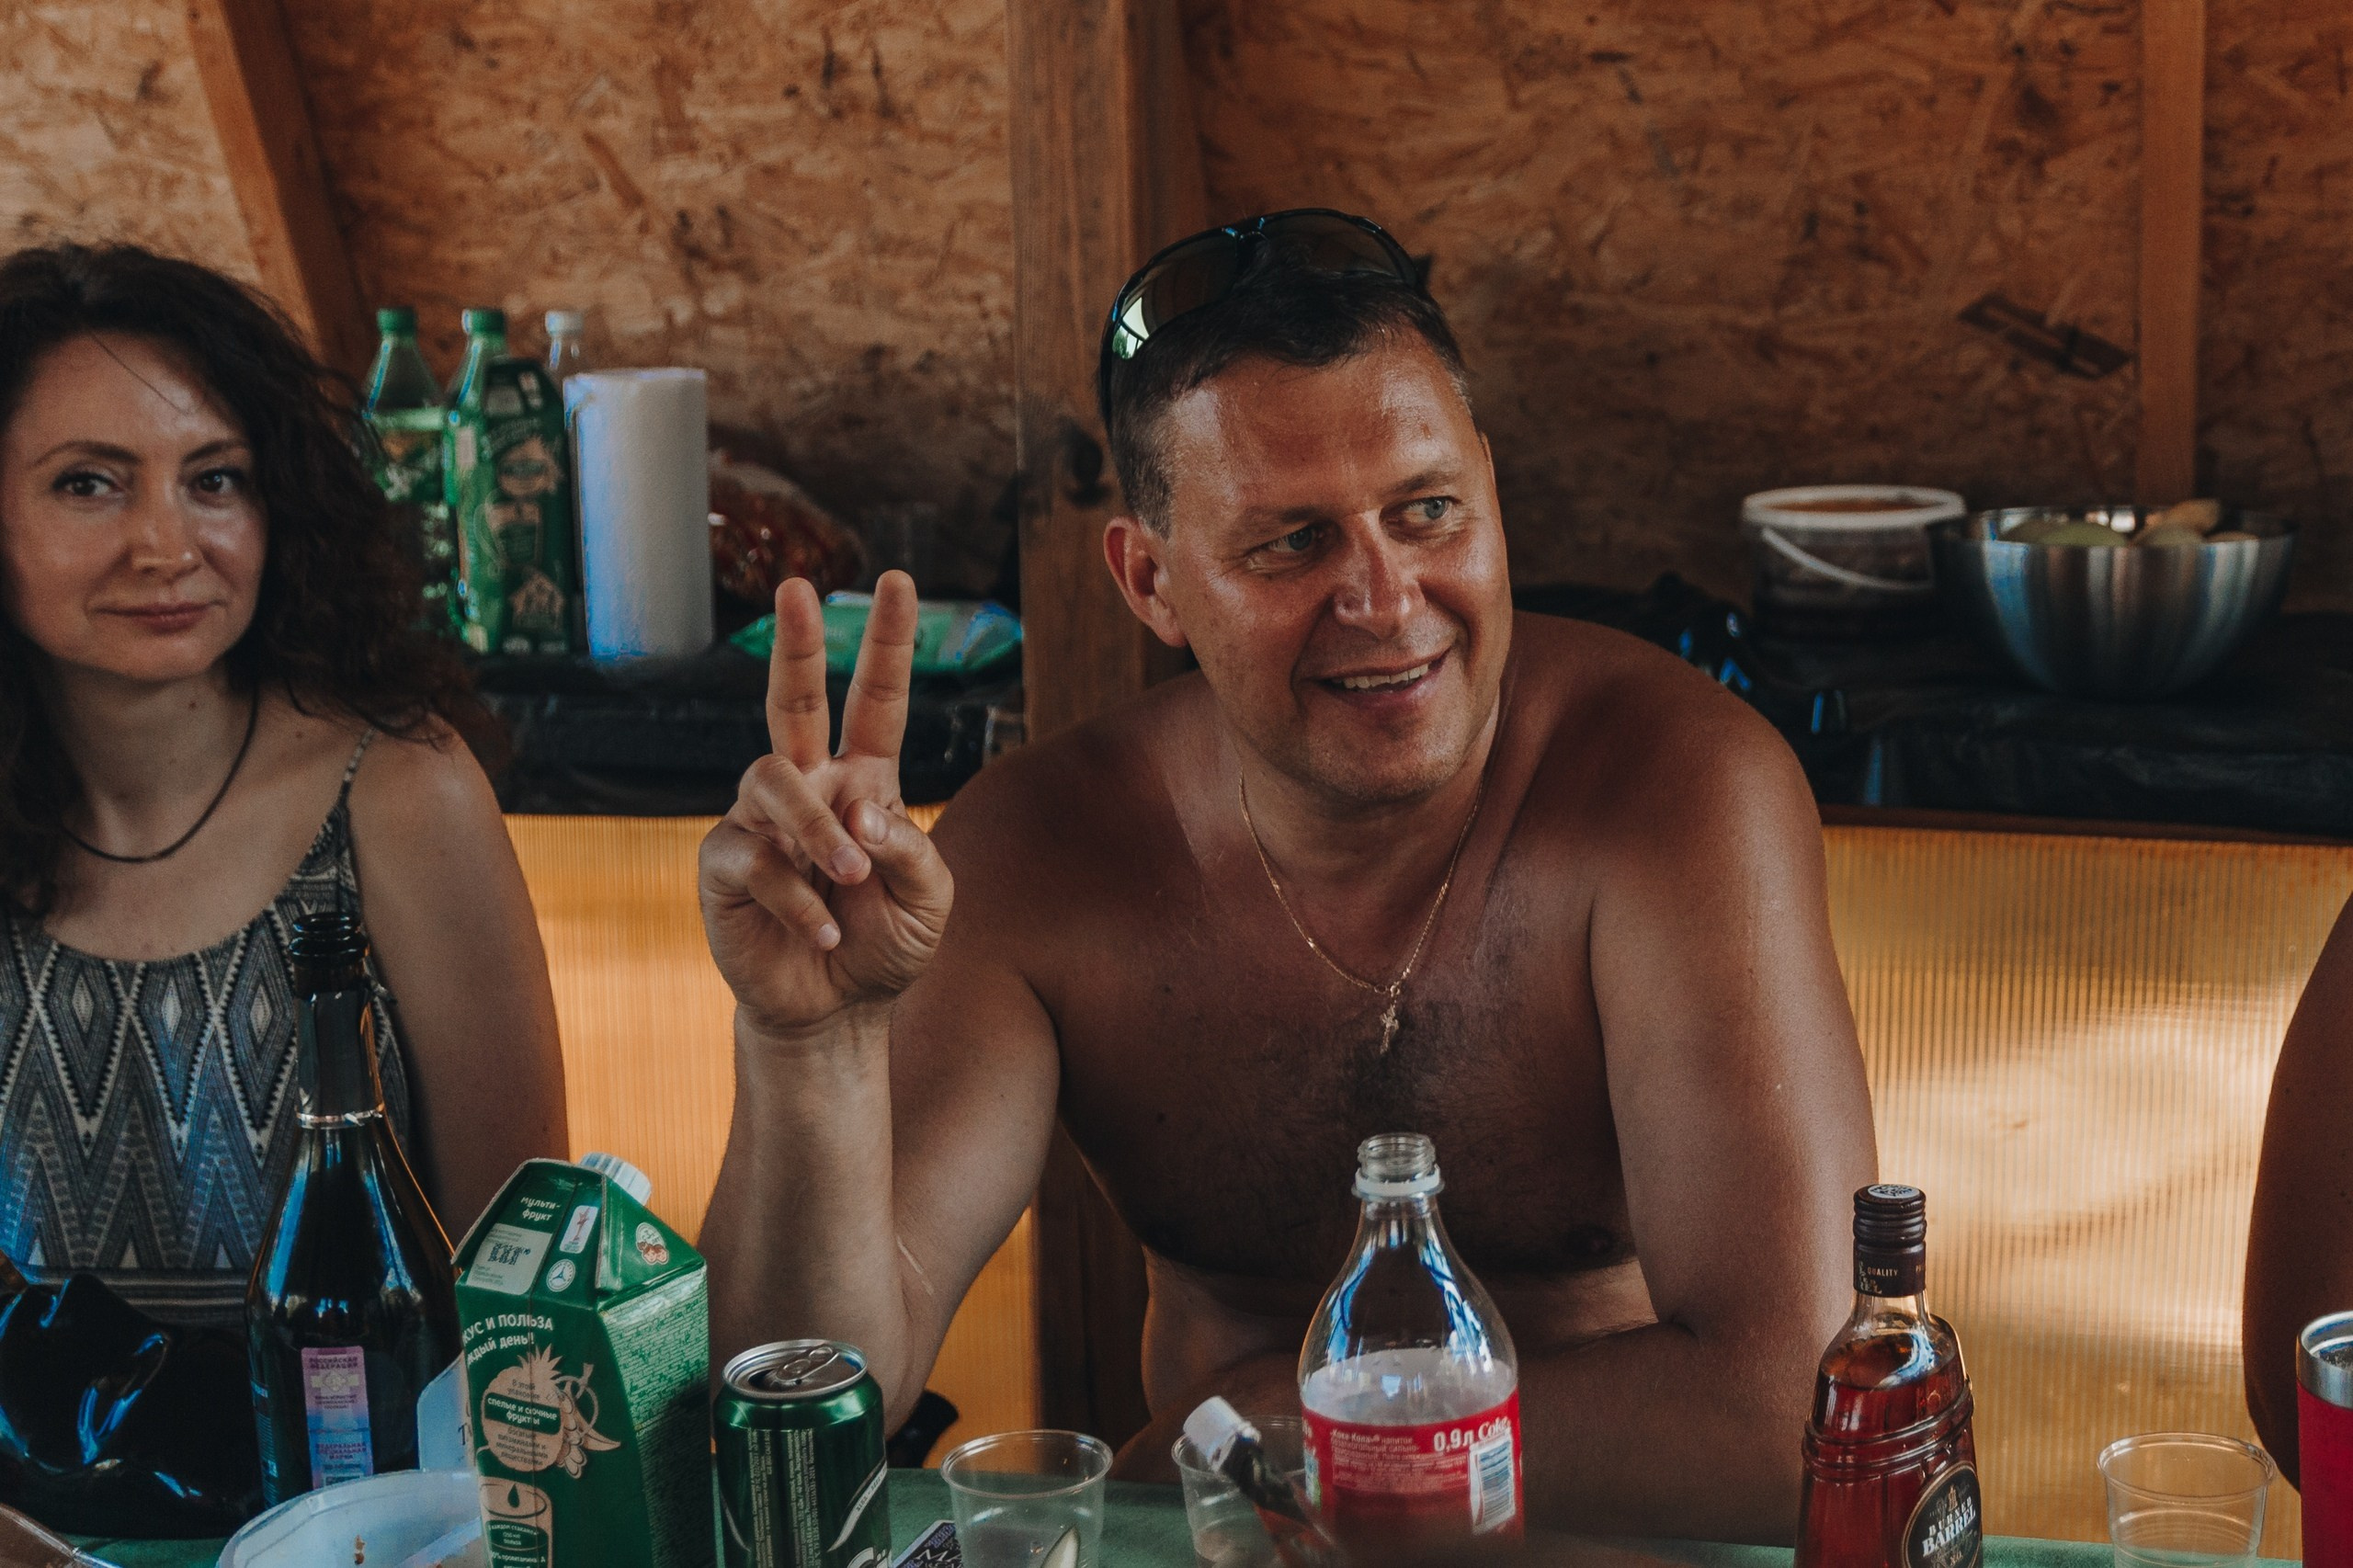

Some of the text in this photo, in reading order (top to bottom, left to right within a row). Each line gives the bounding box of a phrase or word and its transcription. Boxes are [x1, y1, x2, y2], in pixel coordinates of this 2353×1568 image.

[520, 1197, 561, 1210] мульти-
[522, 1209, 551, 1221] фрукт
[1867, 1267, 1898, 1277] QUALITY
[485, 1317, 495, 1330] И
[497, 1313, 553, 1331] ПОЛЬЗА
[487, 1397, 517, 1411] спелые
[1928, 1495, 1972, 1537] BURNED
[1921, 1504, 1976, 1558] BARREL
